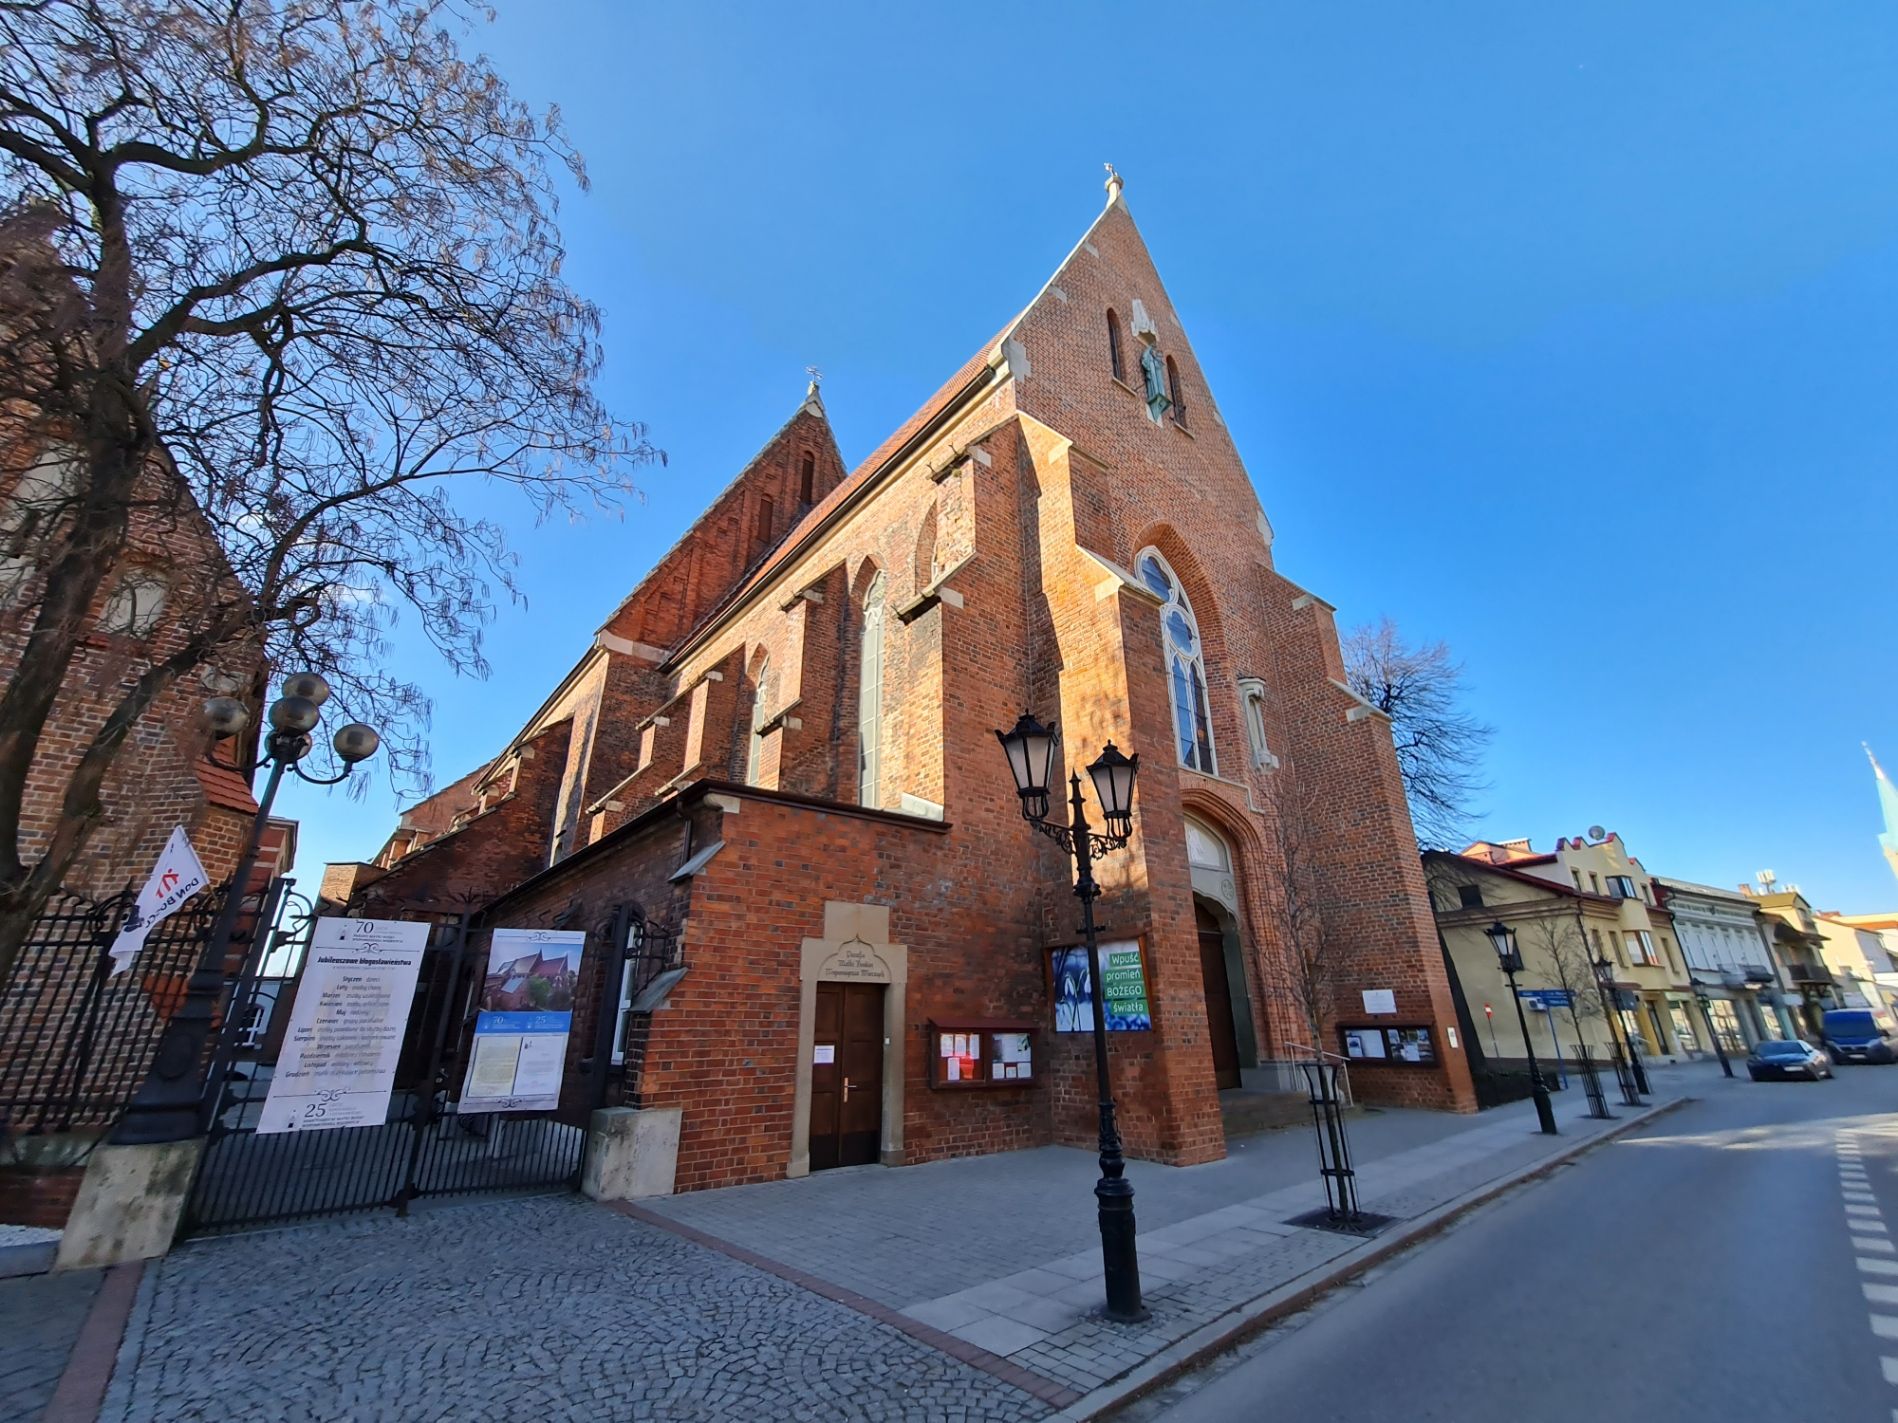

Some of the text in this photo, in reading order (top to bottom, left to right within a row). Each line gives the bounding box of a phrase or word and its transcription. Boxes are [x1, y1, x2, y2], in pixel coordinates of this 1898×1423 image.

[356, 920, 374, 934] 70
[1111, 953, 1139, 966] Wpuść
[1106, 969, 1141, 982] promień
[1107, 985, 1141, 996] BOŻEGO
[1113, 1000, 1143, 1013] światła
[304, 1102, 327, 1118] 25
